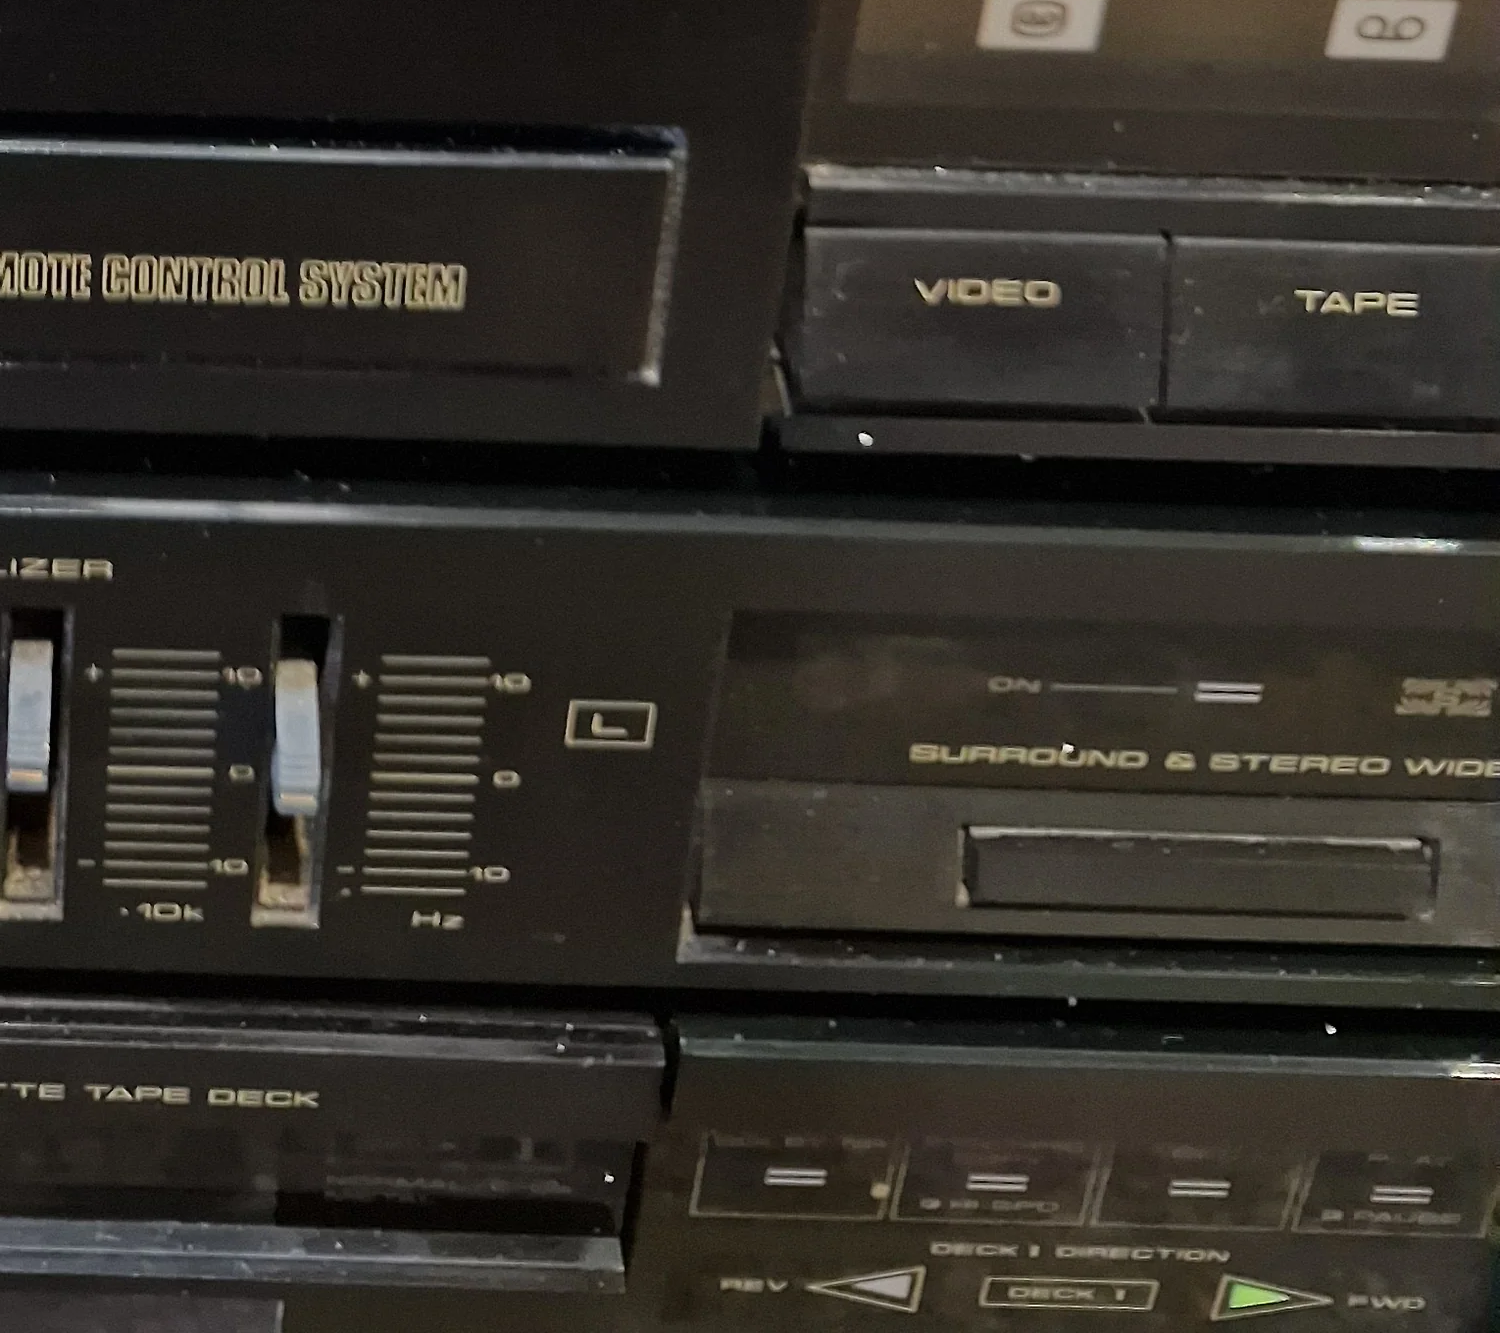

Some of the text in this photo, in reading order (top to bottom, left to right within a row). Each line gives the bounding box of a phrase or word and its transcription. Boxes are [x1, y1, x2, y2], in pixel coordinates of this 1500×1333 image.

[101, 254, 290, 305] CONTROL
[298, 259, 467, 310] SYSTEM
[914, 278, 1061, 307] VIDEO
[1294, 289, 1419, 317] TAPE
[223, 667, 262, 685] 10
[489, 673, 531, 692] 10
[987, 676, 1042, 694] ON
[590, 712, 628, 737] L
[909, 742, 1149, 769] SURROUND
[1164, 751, 1196, 771] &
[1209, 753, 1391, 775] STEREO
[209, 858, 249, 875] 10
[469, 866, 510, 883] 10
[411, 910, 464, 930] Hz
[84, 1084, 190, 1104] TAPE
[207, 1088, 319, 1108] DECK
[930, 1241, 1019, 1257] DECK
[1054, 1245, 1231, 1263] DIRECTION
[1007, 1286, 1095, 1301] DECK
